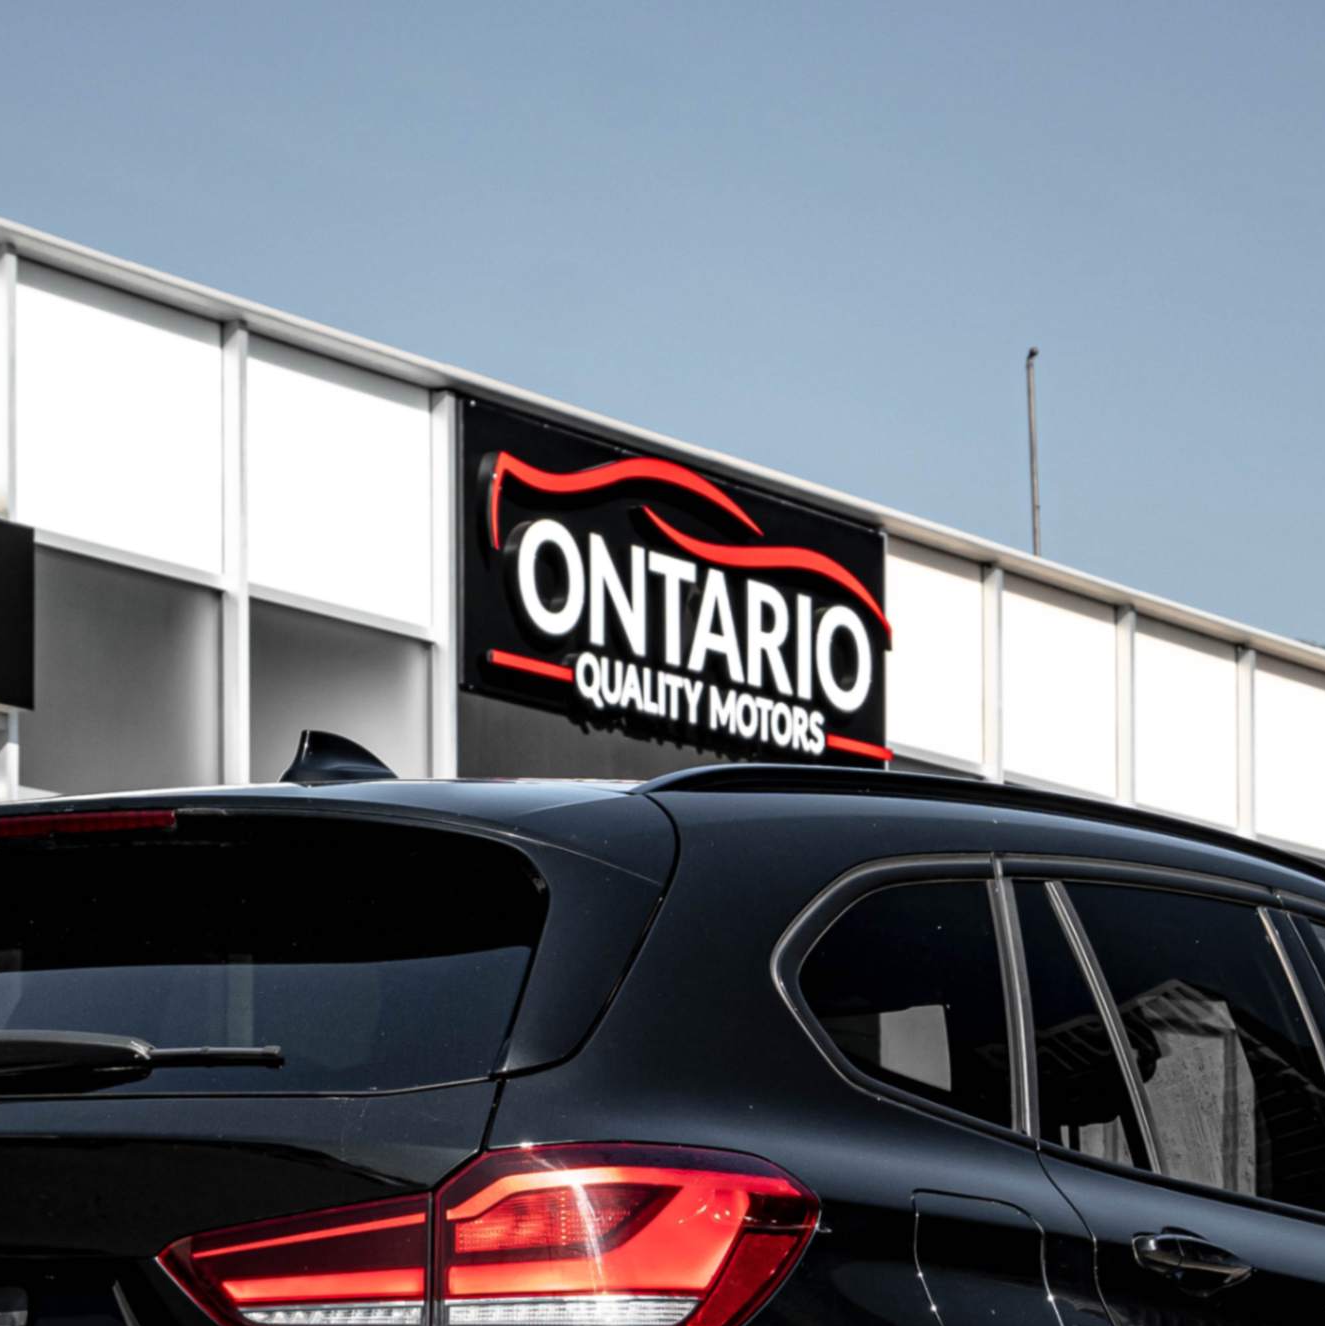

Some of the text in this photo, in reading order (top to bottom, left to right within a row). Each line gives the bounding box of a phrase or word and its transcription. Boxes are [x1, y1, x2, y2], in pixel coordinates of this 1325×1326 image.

[518, 518, 873, 713] ONTARIO
[575, 651, 826, 756] QUALITY MOTORS
